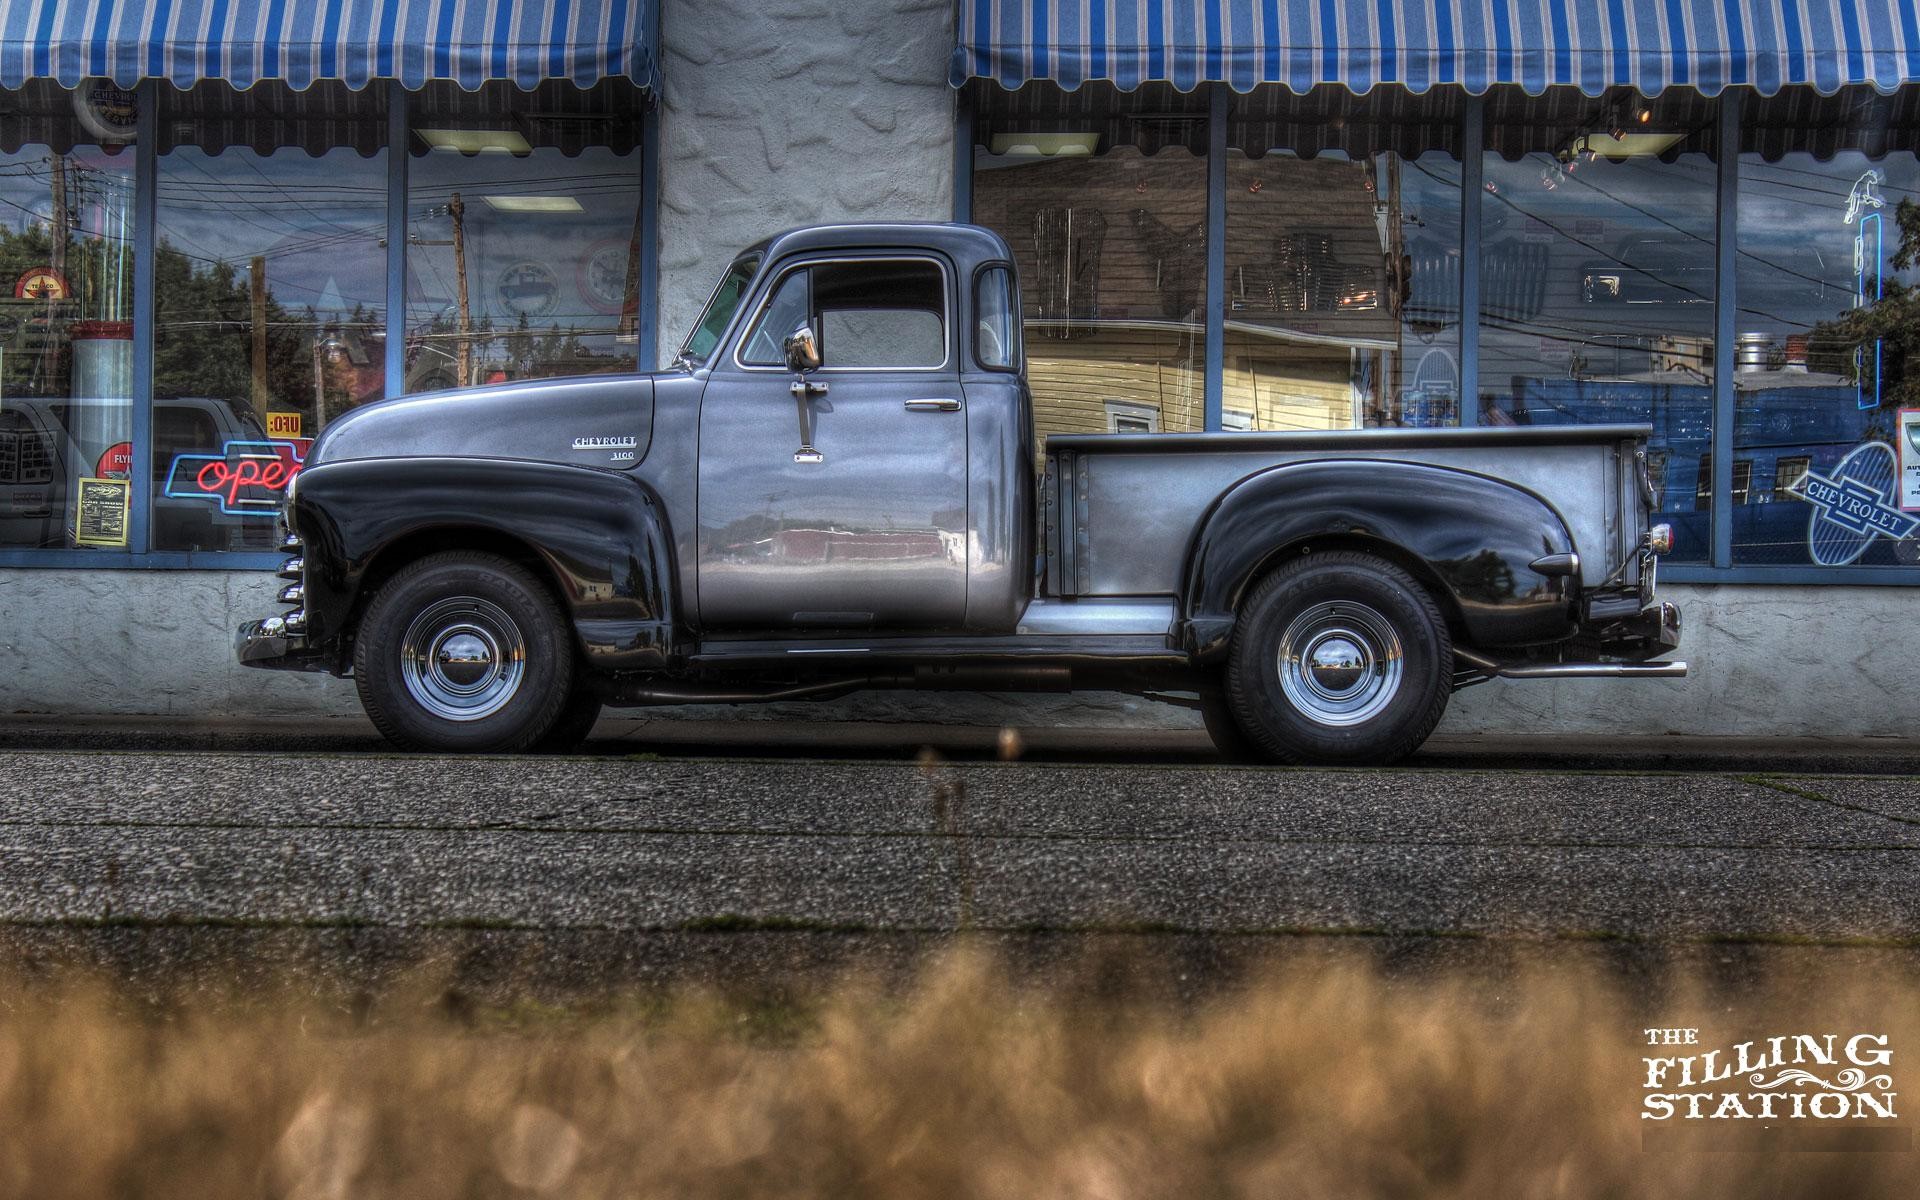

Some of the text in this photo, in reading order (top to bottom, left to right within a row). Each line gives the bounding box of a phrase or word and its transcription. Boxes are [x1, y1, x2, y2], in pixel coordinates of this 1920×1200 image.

[574, 436, 636, 446] CHEVROLET
[612, 451, 634, 460] 3100
[197, 460, 302, 505] ope
[1807, 481, 1902, 531] CHEVROLET
